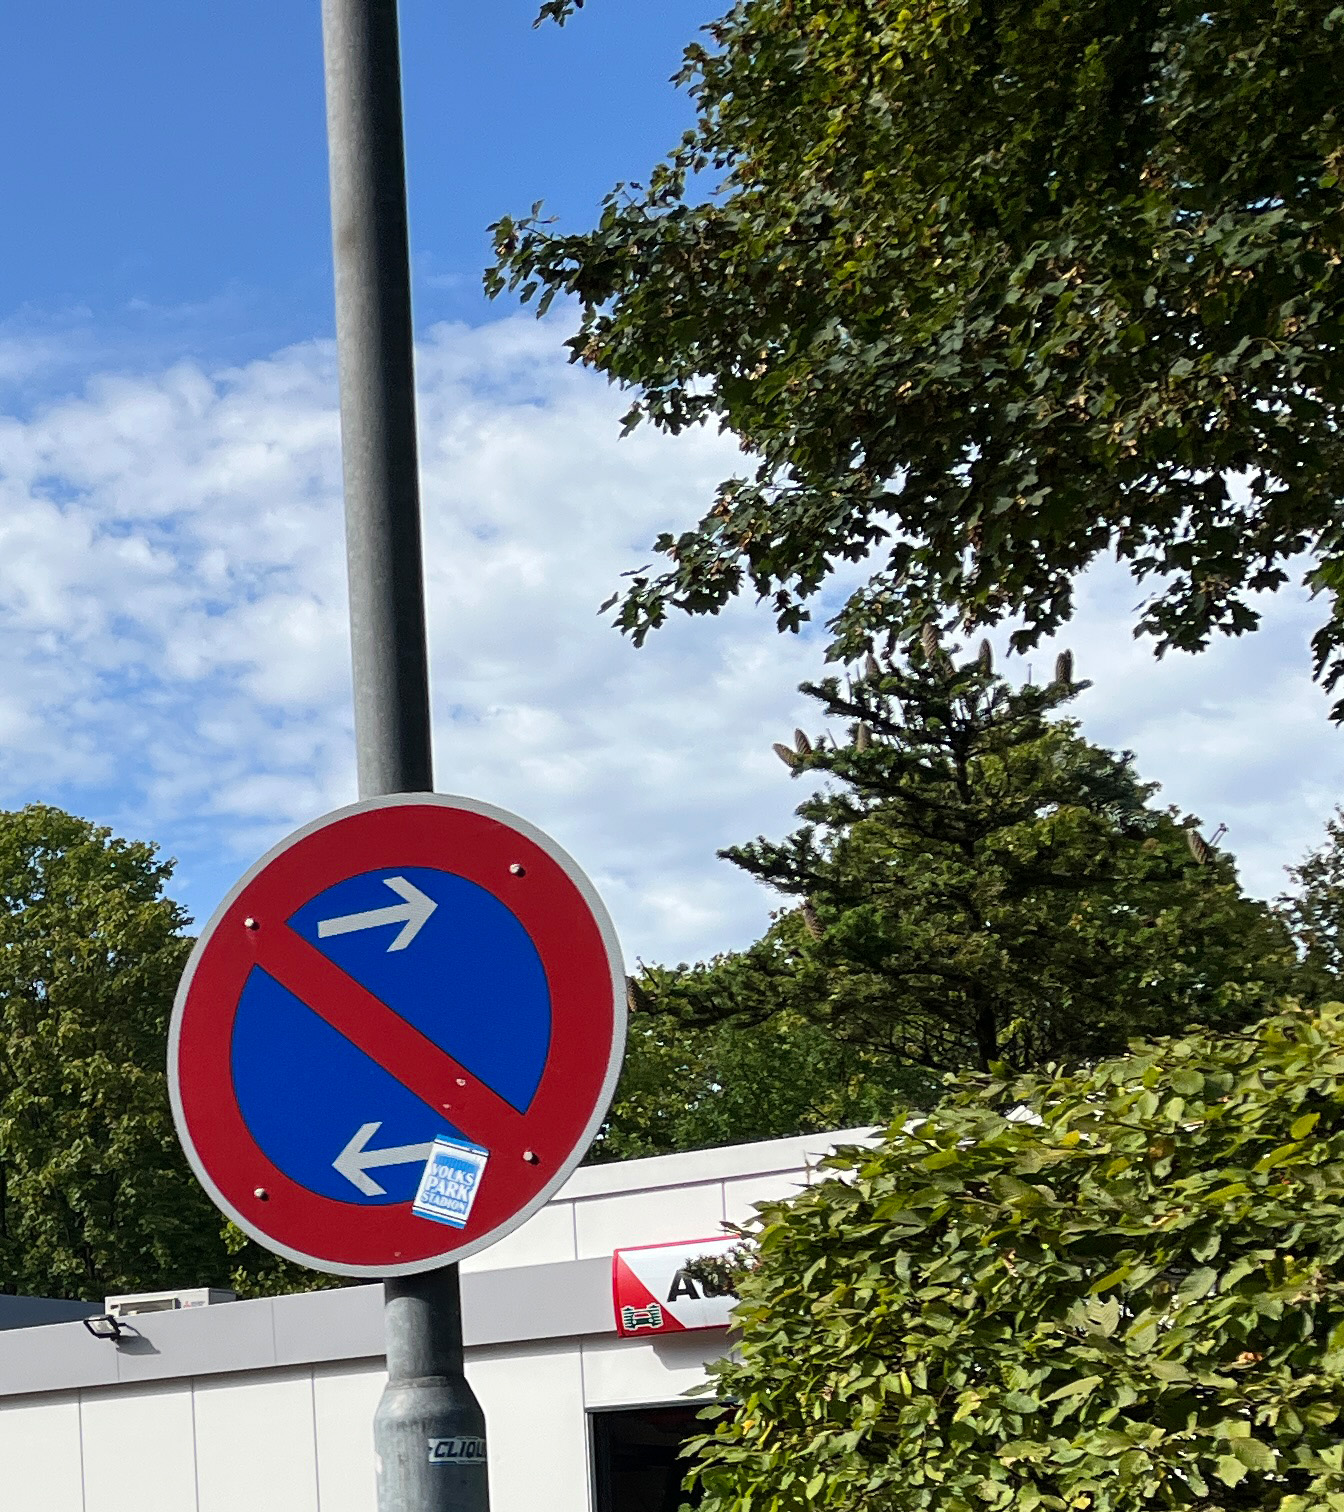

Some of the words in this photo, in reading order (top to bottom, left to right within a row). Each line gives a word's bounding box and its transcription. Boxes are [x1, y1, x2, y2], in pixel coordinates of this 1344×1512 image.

[430, 1163, 475, 1187] VOLKS
[424, 1175, 472, 1203] PARK
[421, 1191, 467, 1213] STADION
